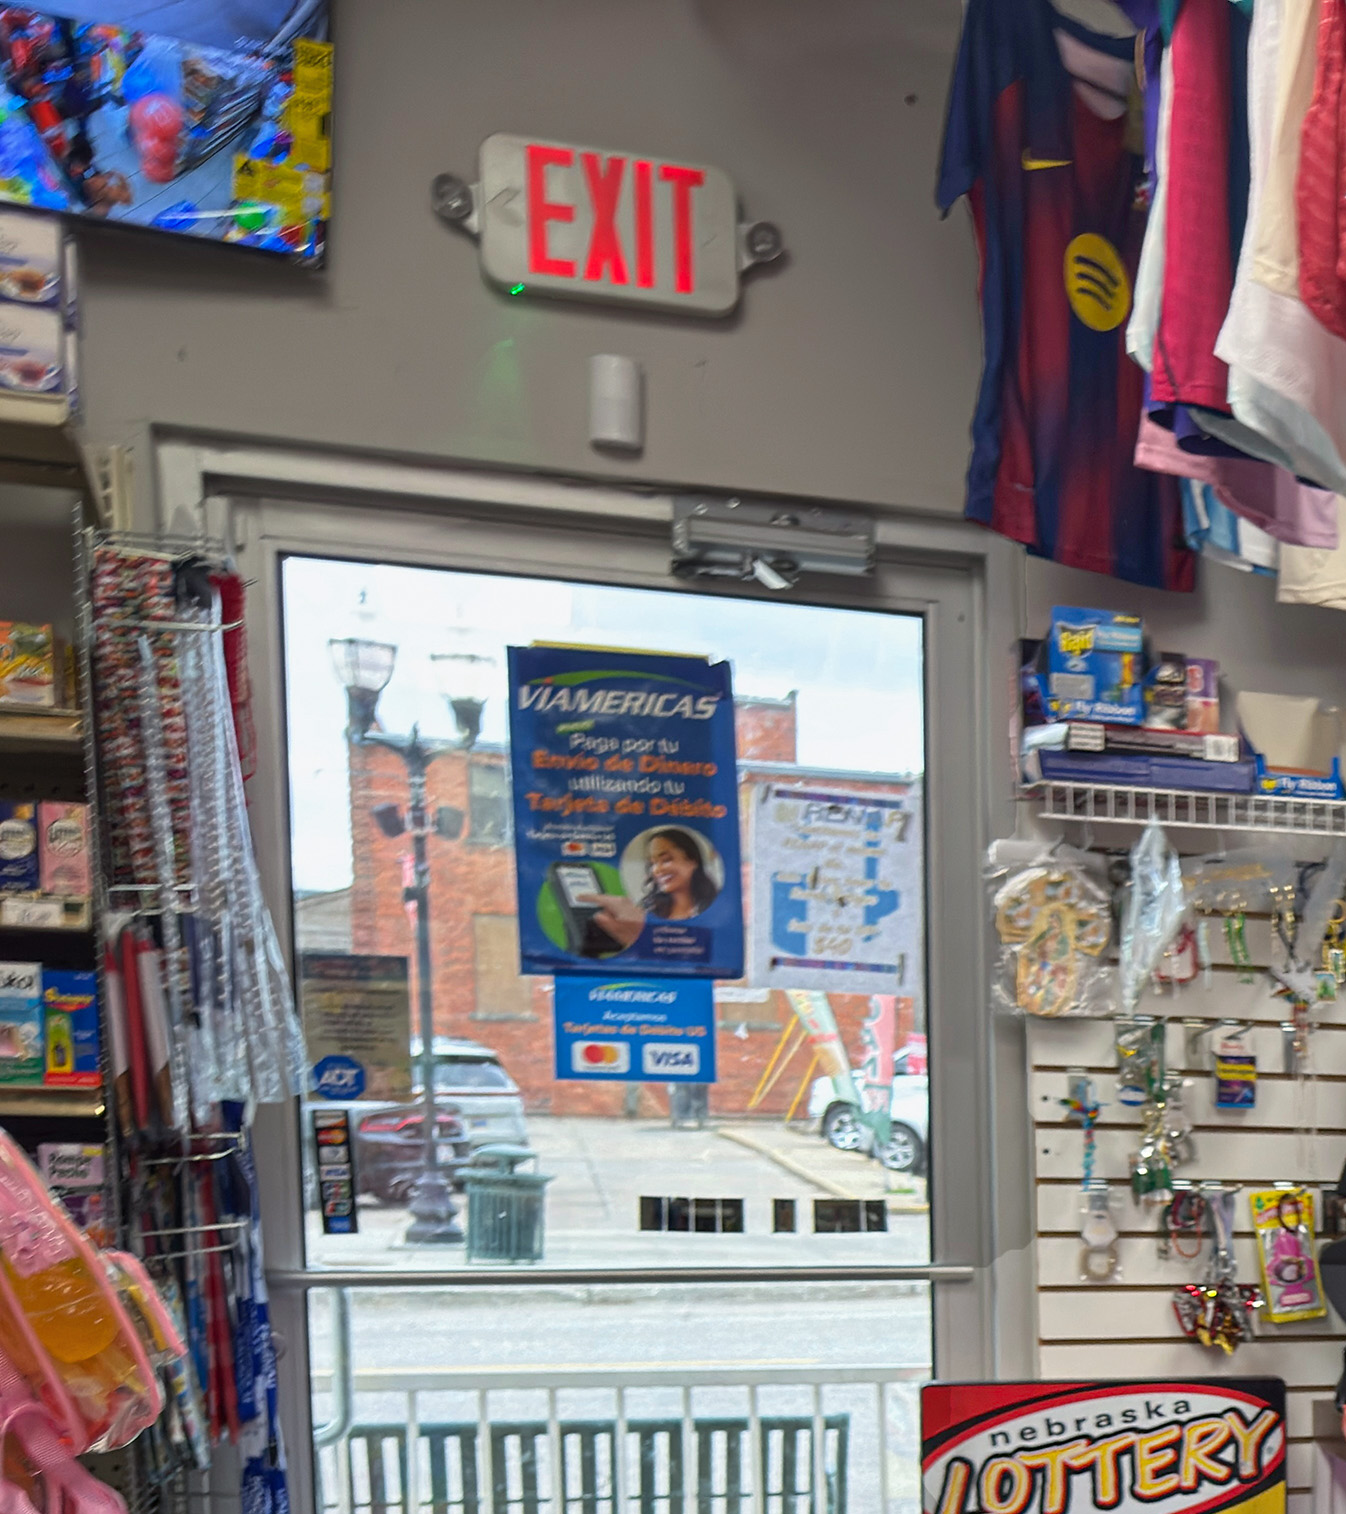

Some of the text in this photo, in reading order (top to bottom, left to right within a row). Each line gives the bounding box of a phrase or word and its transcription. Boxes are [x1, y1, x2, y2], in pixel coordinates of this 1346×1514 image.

[525, 144, 706, 295] EXIT
[517, 683, 721, 722] VIAMERICAS
[649, 1050, 695, 1068] VISA
[988, 1398, 1192, 1448] nebraska
